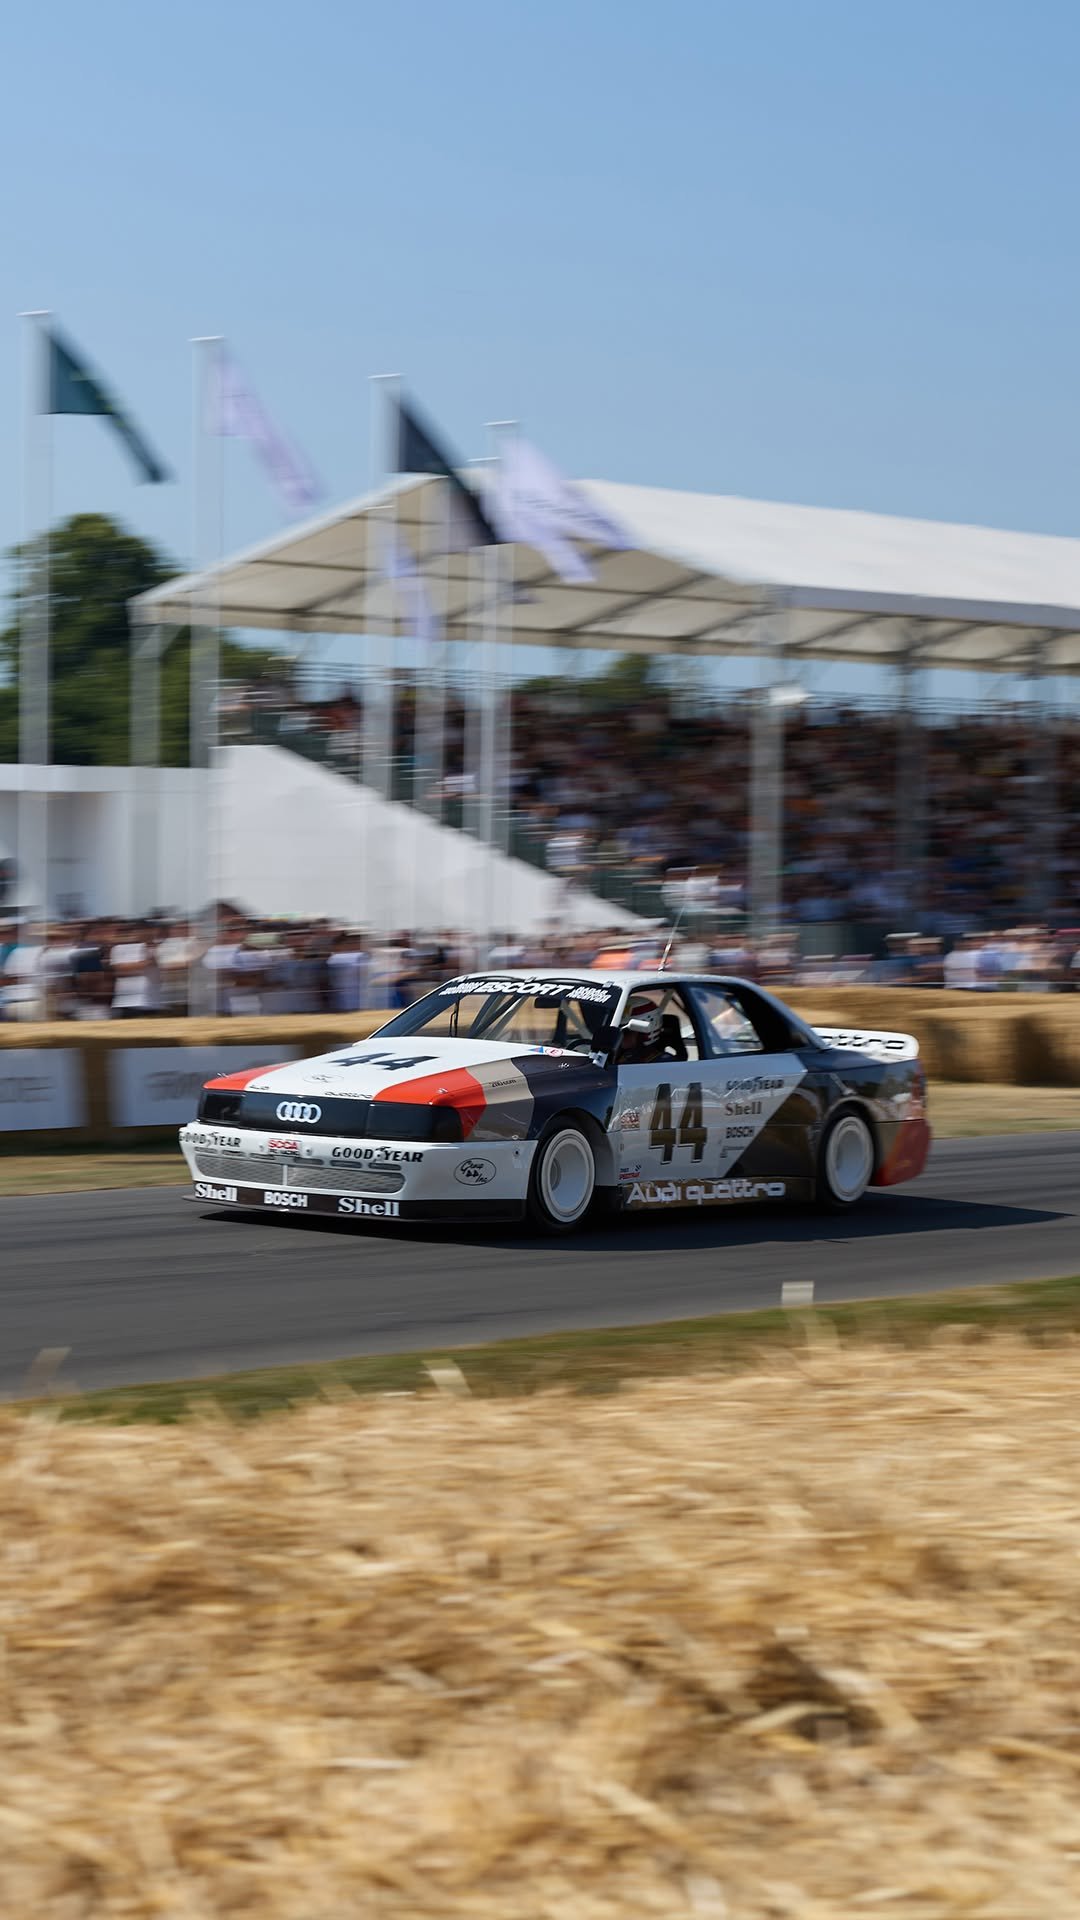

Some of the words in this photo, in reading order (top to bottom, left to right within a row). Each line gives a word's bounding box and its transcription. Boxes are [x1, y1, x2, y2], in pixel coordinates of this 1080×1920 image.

[472, 981, 575, 997] ESCORT
[328, 1053, 440, 1071] 44
[725, 1101, 762, 1116] Shell
[649, 1082, 708, 1165] 44
[726, 1126, 754, 1139] BOSCH
[195, 1183, 238, 1202] Shell
[264, 1190, 308, 1207] BOSCH
[626, 1181, 682, 1204] Audi
[686, 1179, 786, 1205] quattro
[338, 1197, 400, 1217] Shell
